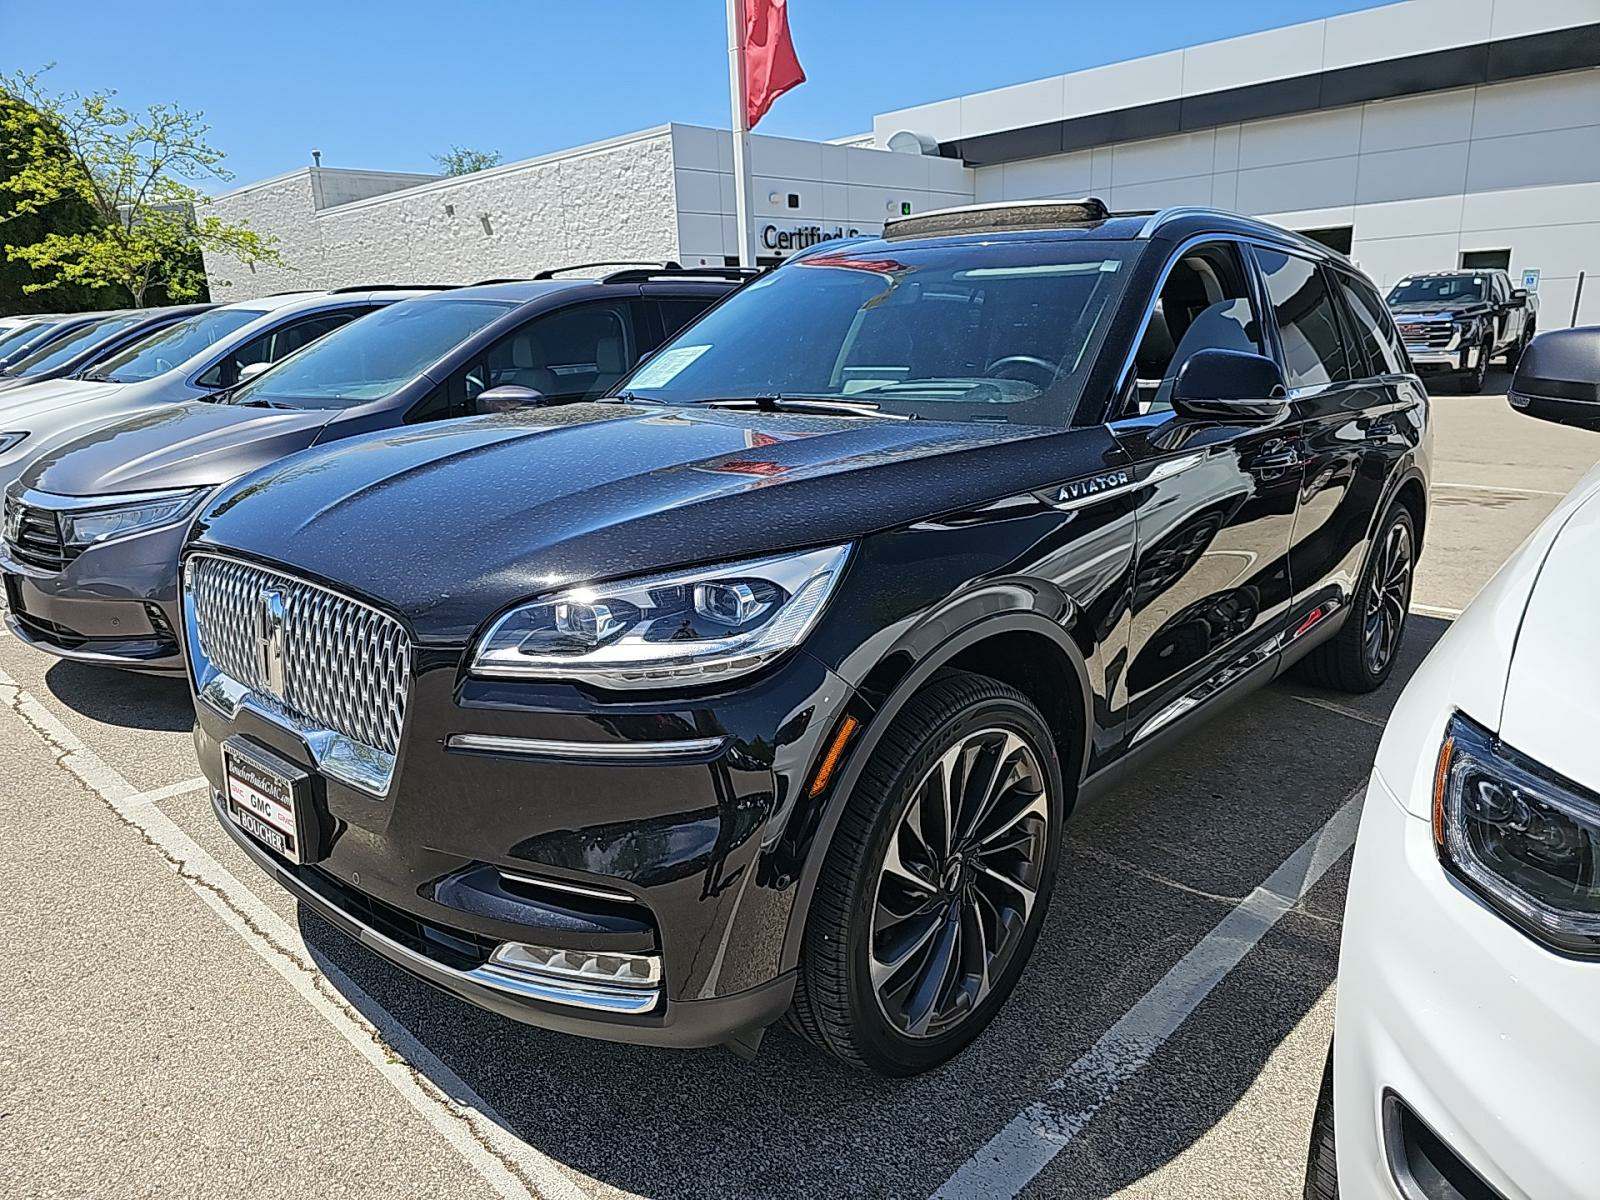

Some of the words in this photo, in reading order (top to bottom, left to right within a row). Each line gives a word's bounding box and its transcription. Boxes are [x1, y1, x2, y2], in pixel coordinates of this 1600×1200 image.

[1058, 472, 1128, 501] AVIATOR
[250, 794, 272, 817] GMC
[241, 812, 283, 852] BOUCHER
